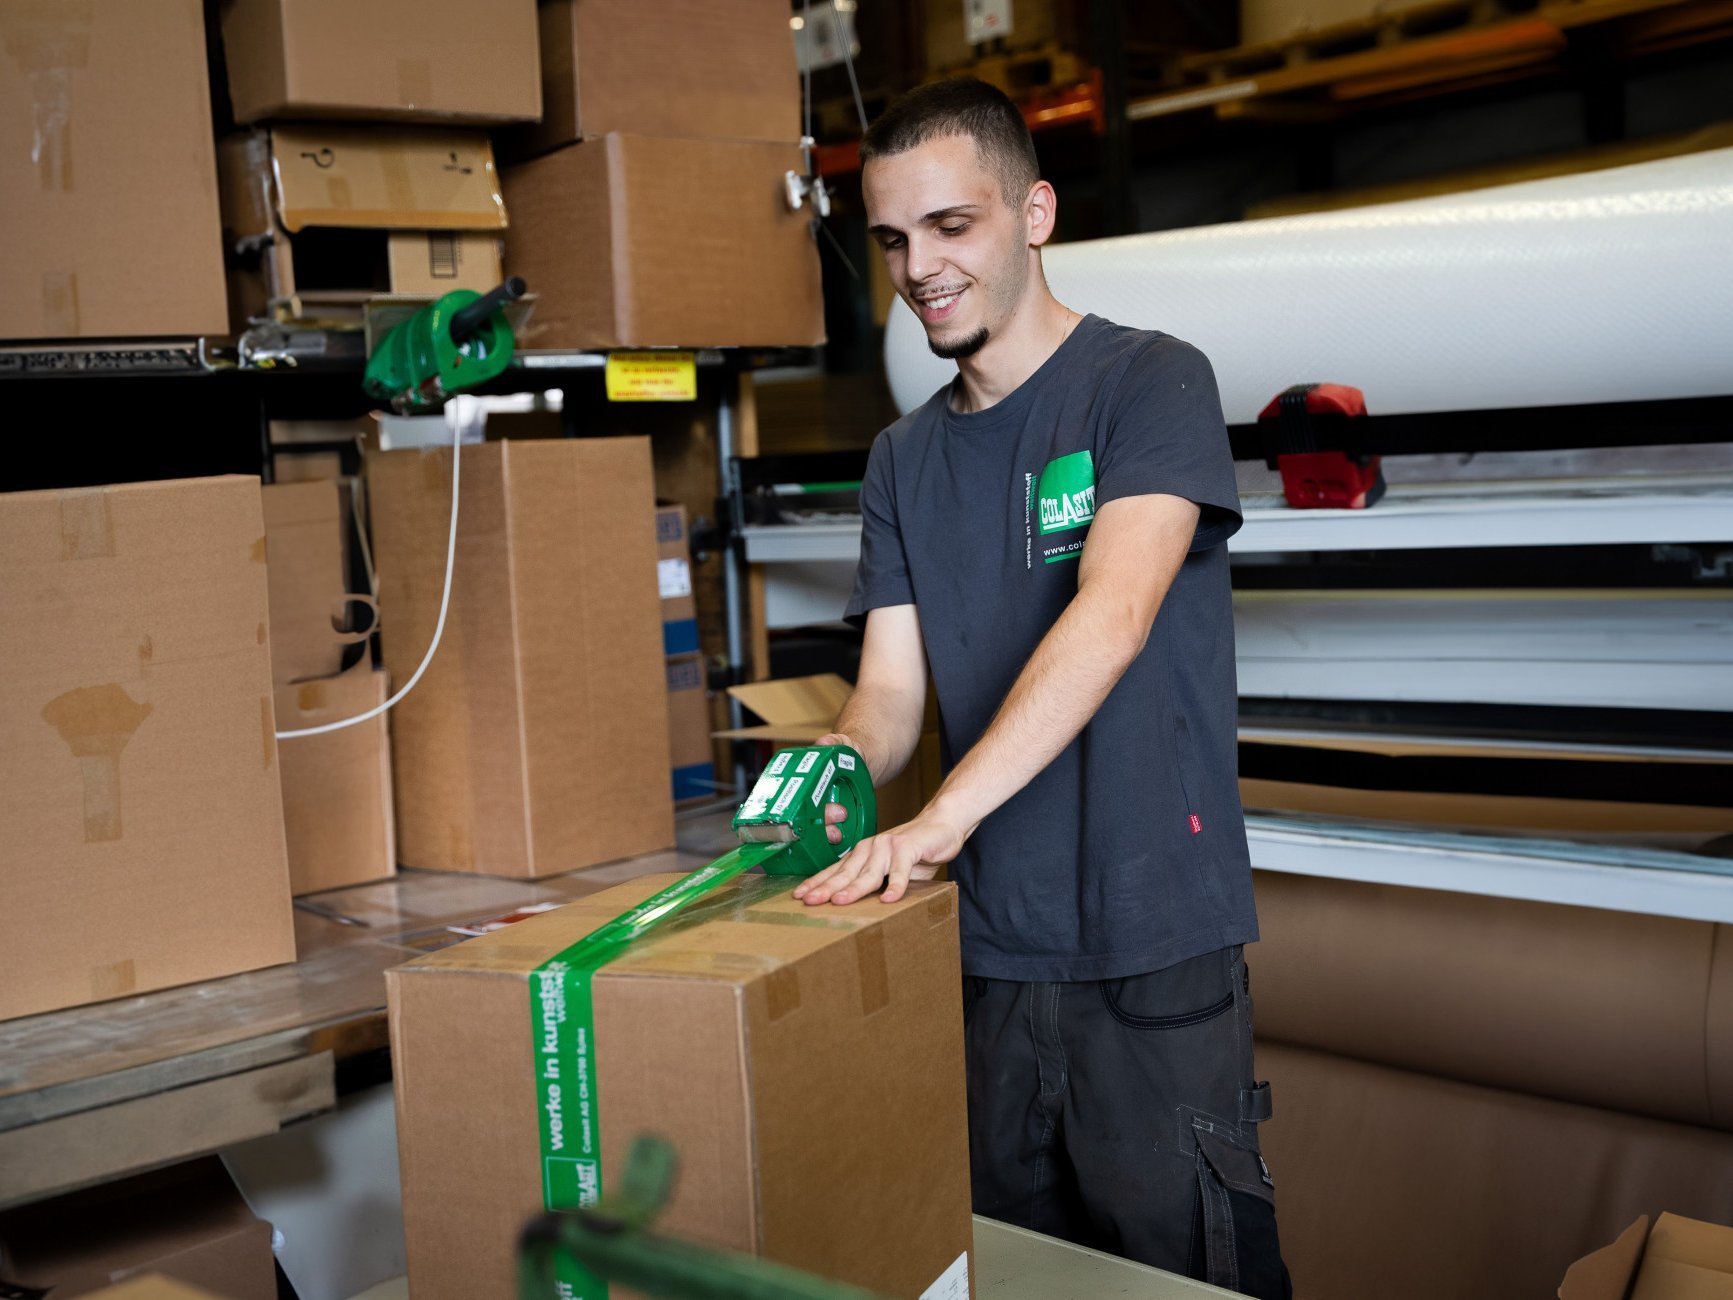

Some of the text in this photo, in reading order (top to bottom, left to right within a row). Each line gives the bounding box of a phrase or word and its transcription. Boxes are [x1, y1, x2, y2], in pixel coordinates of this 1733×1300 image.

[1043, 540, 1085, 556] www.col
[539, 962, 563, 1150] werke in kunstst
[580, 1100, 589, 1117] AG
